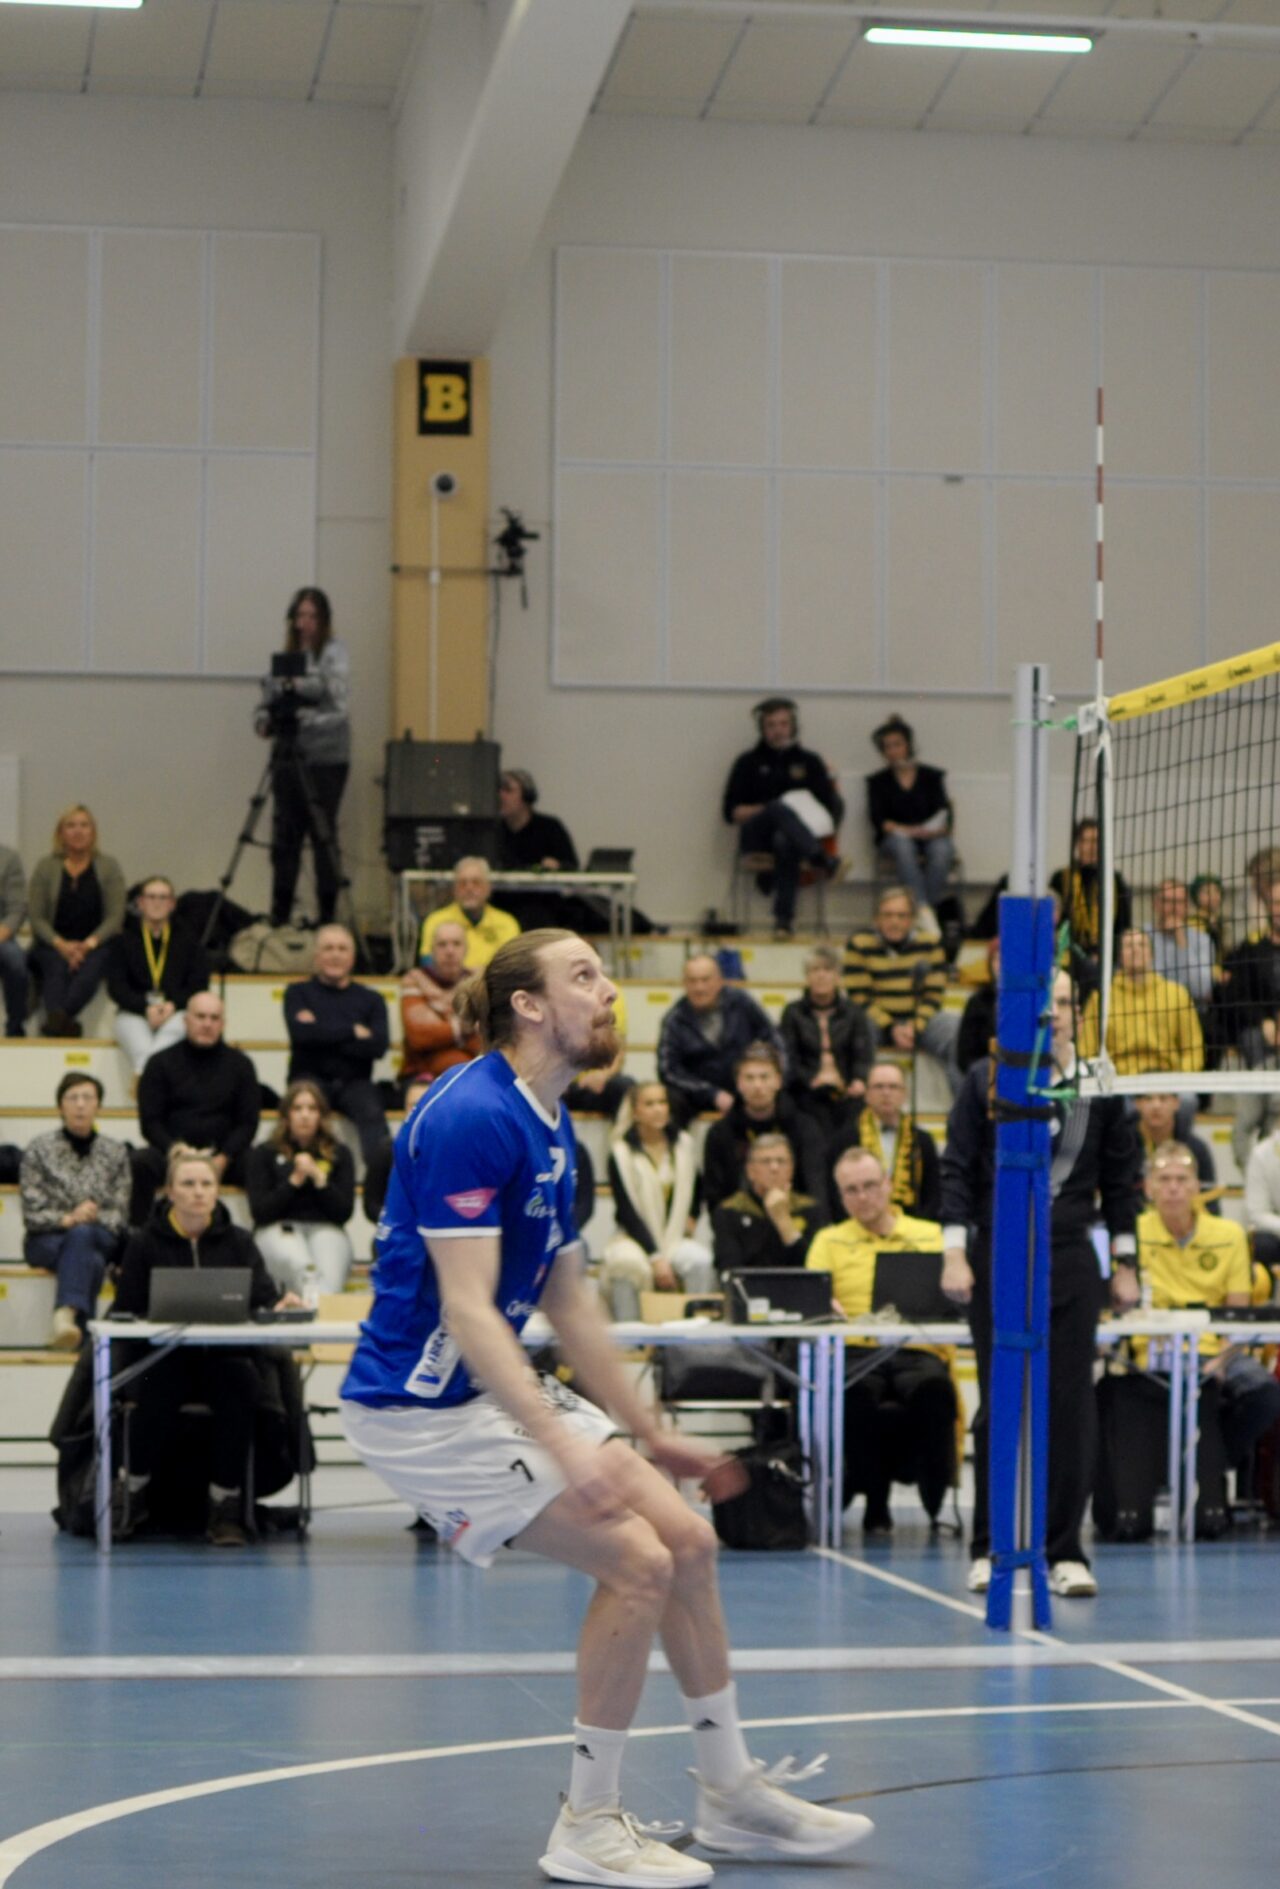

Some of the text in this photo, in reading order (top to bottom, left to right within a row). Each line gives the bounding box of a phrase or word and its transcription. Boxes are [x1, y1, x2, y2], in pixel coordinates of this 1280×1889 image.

[424, 373, 467, 421] B
[549, 1146, 566, 1185] 7
[509, 1458, 536, 1484] 7
